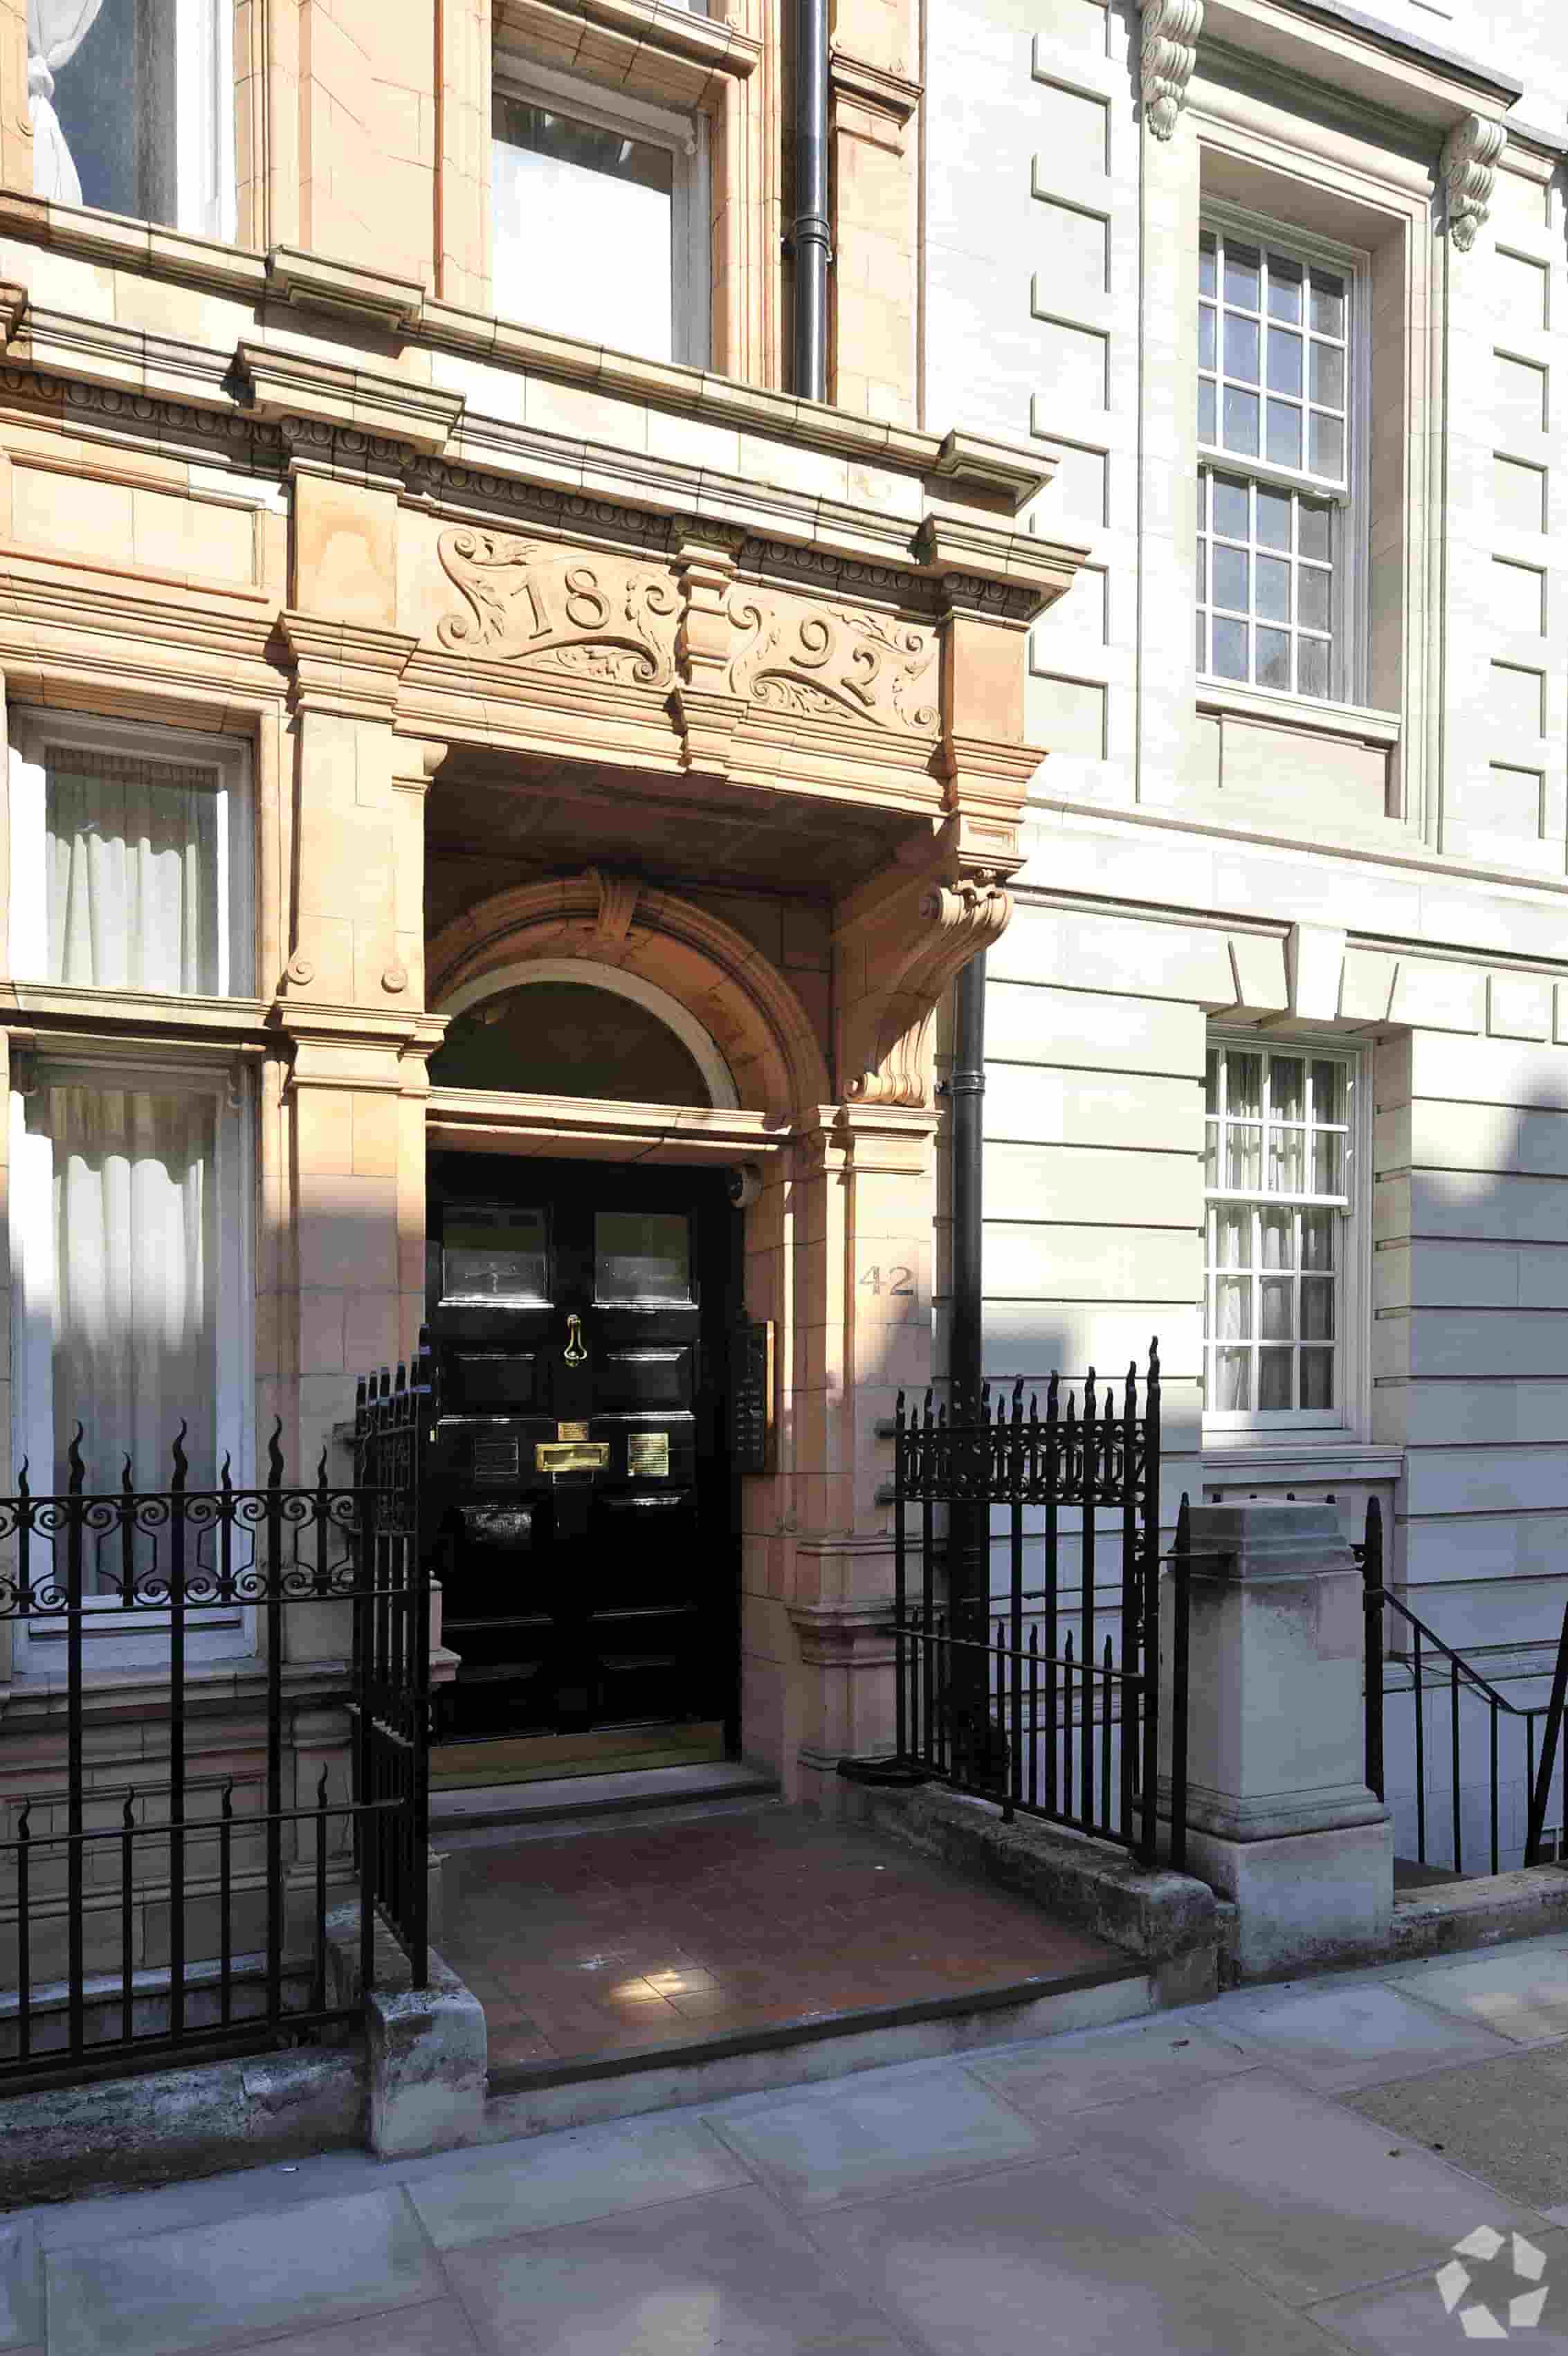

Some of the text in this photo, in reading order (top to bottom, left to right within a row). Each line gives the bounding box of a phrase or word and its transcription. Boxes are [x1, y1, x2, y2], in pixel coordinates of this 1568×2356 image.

[510, 568, 880, 706] 18 92
[860, 1266, 914, 1296] 42
